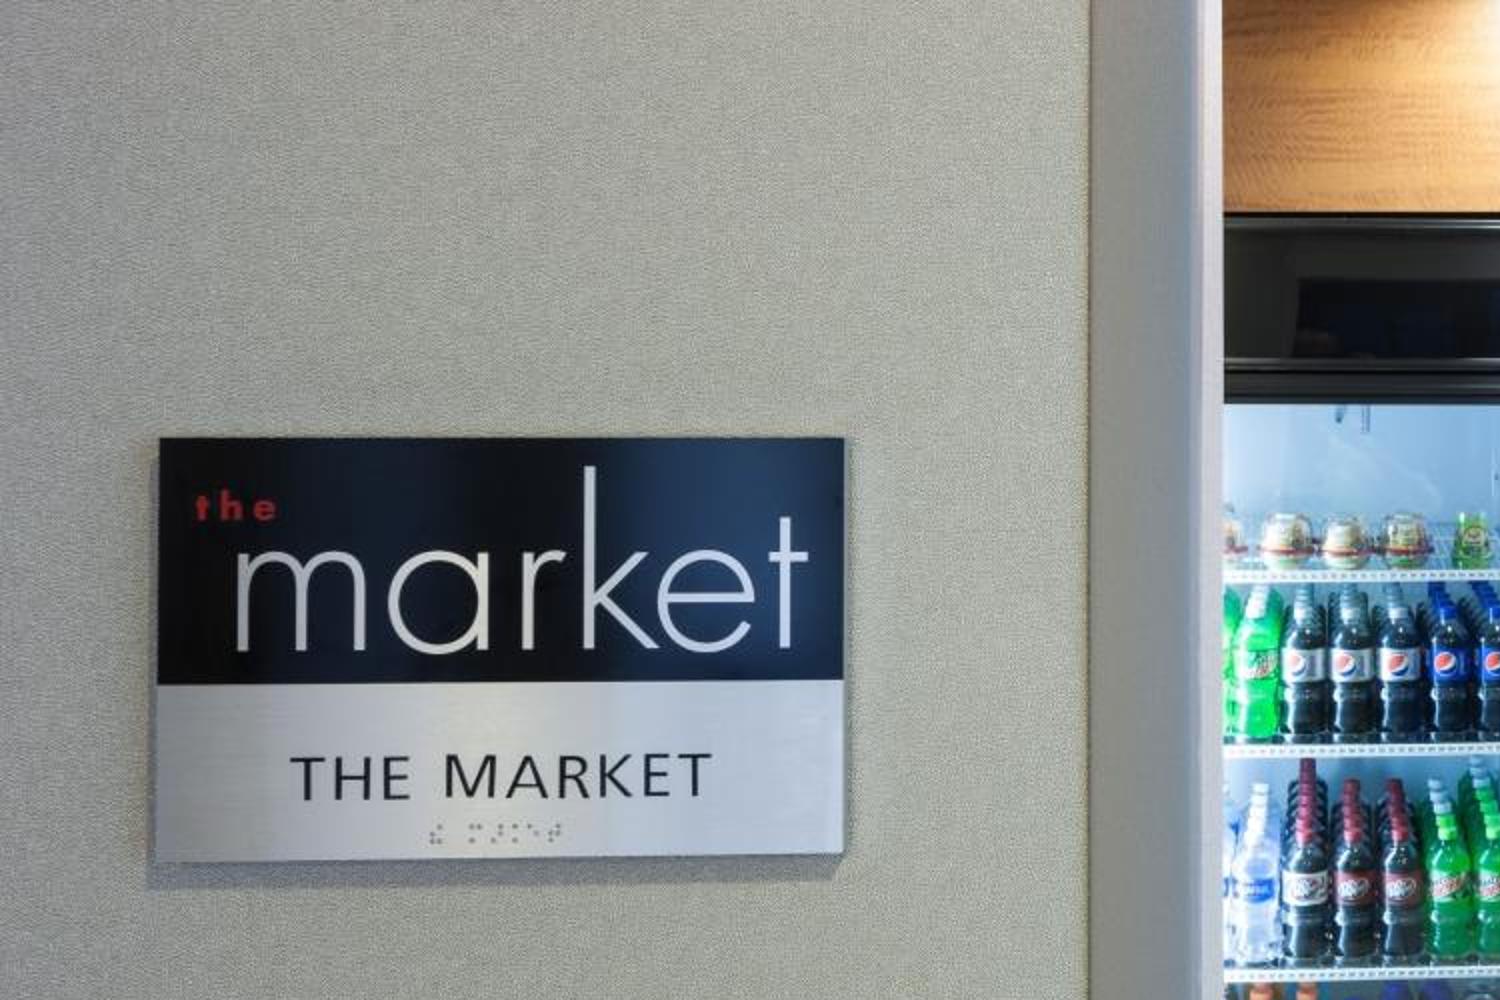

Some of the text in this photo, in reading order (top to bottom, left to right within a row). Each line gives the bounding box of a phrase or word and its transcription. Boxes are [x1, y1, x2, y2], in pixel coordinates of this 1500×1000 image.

[195, 489, 276, 521] the
[236, 465, 809, 654] market
[290, 753, 712, 801] THE MARKET
